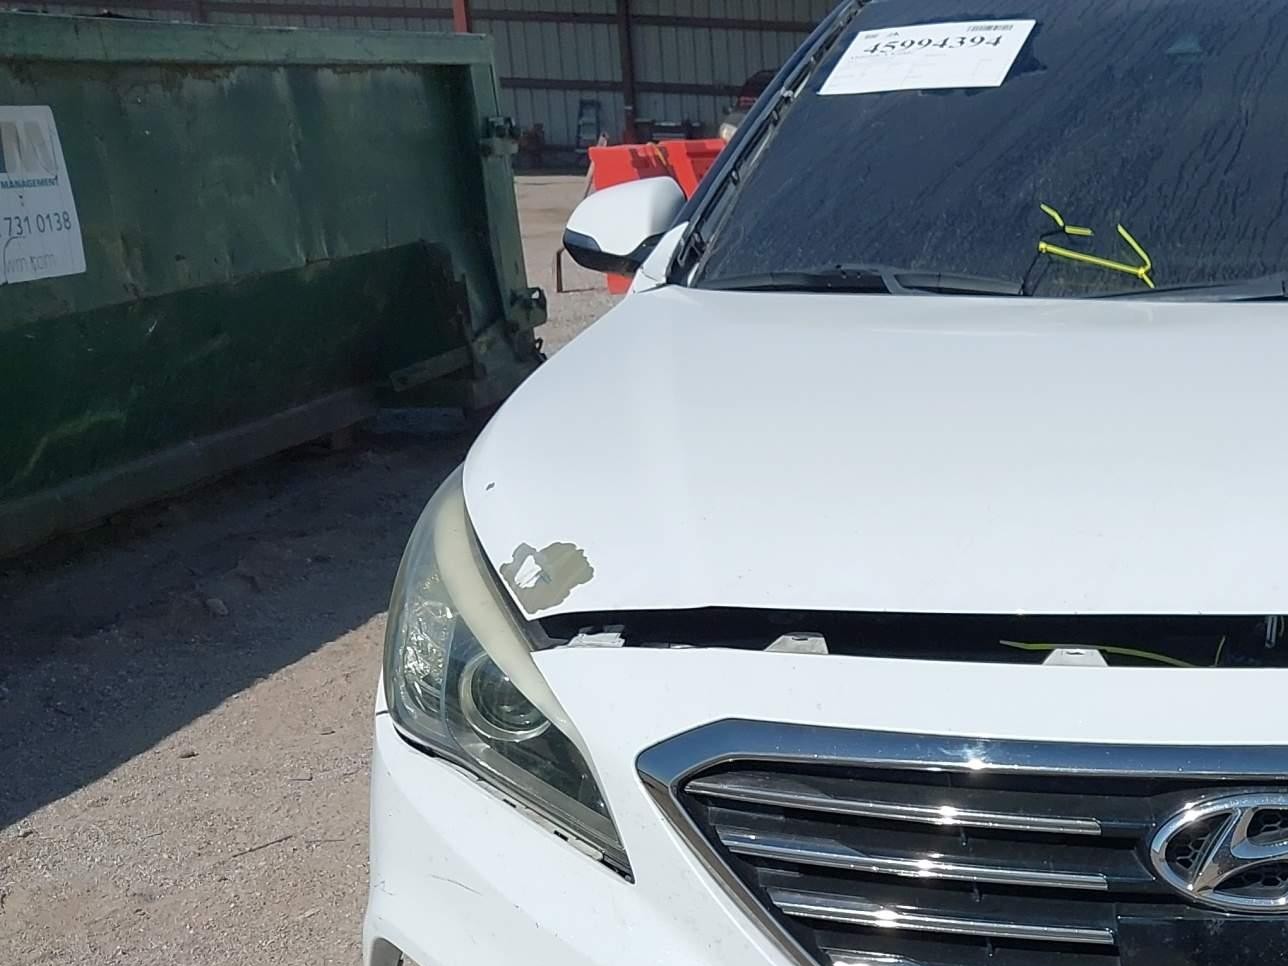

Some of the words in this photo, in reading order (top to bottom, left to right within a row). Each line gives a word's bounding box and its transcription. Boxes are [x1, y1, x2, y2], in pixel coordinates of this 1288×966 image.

[863, 34, 1003, 55] 45994394
[0, 177, 59, 189] MANAGEMENT
[3, 215, 32, 236] 731
[36, 212, 72, 233] 0138
